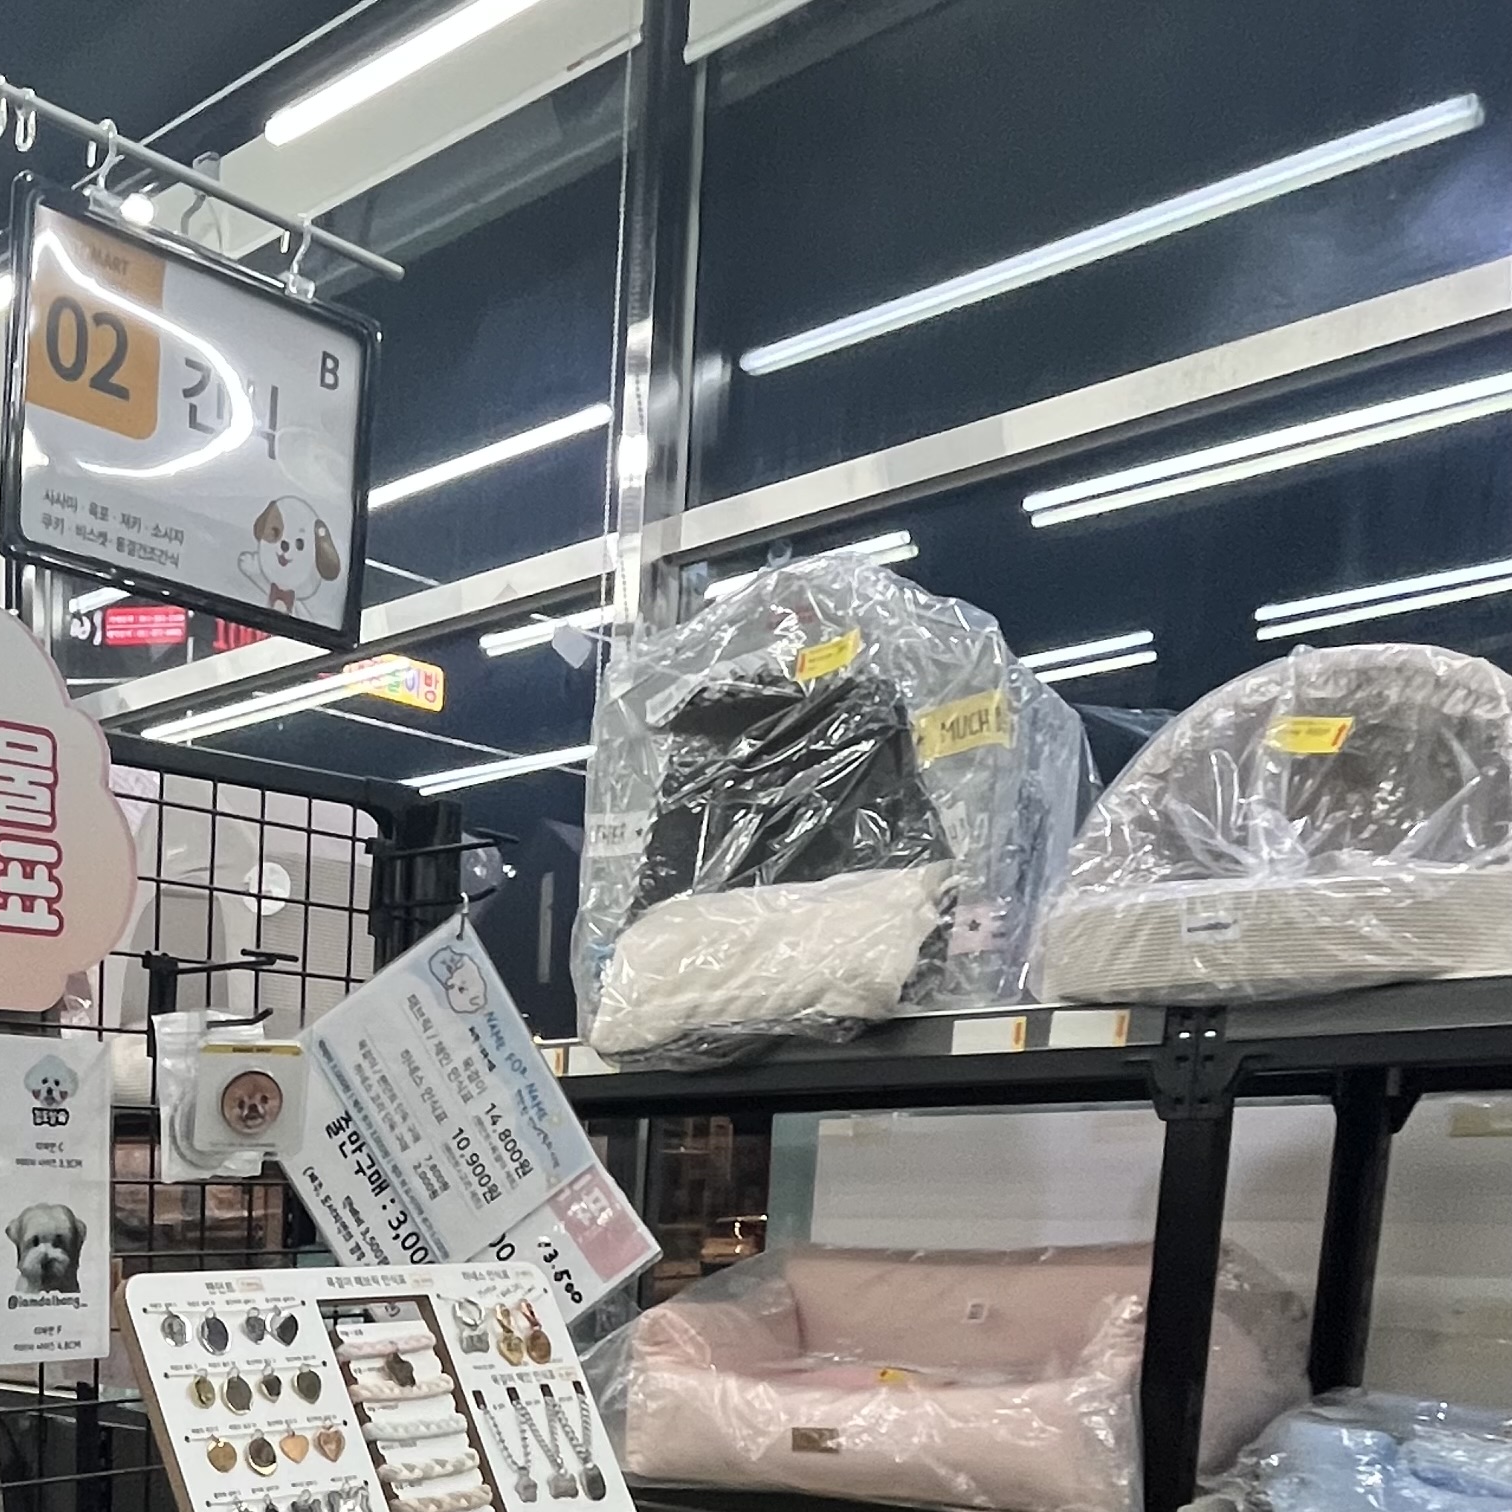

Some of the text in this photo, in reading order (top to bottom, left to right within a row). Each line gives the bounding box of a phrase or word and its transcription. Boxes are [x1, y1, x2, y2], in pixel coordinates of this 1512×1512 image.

[44, 295, 131, 402] 02
[319, 350, 340, 391] B
[41, 512, 65, 535] 쿠키
[419, 1085, 448, 1125] 인식표
[446, 1065, 474, 1104] 인식표
[451, 1126, 501, 1204] 10,900원
[387, 1209, 433, 1265] 3,00
